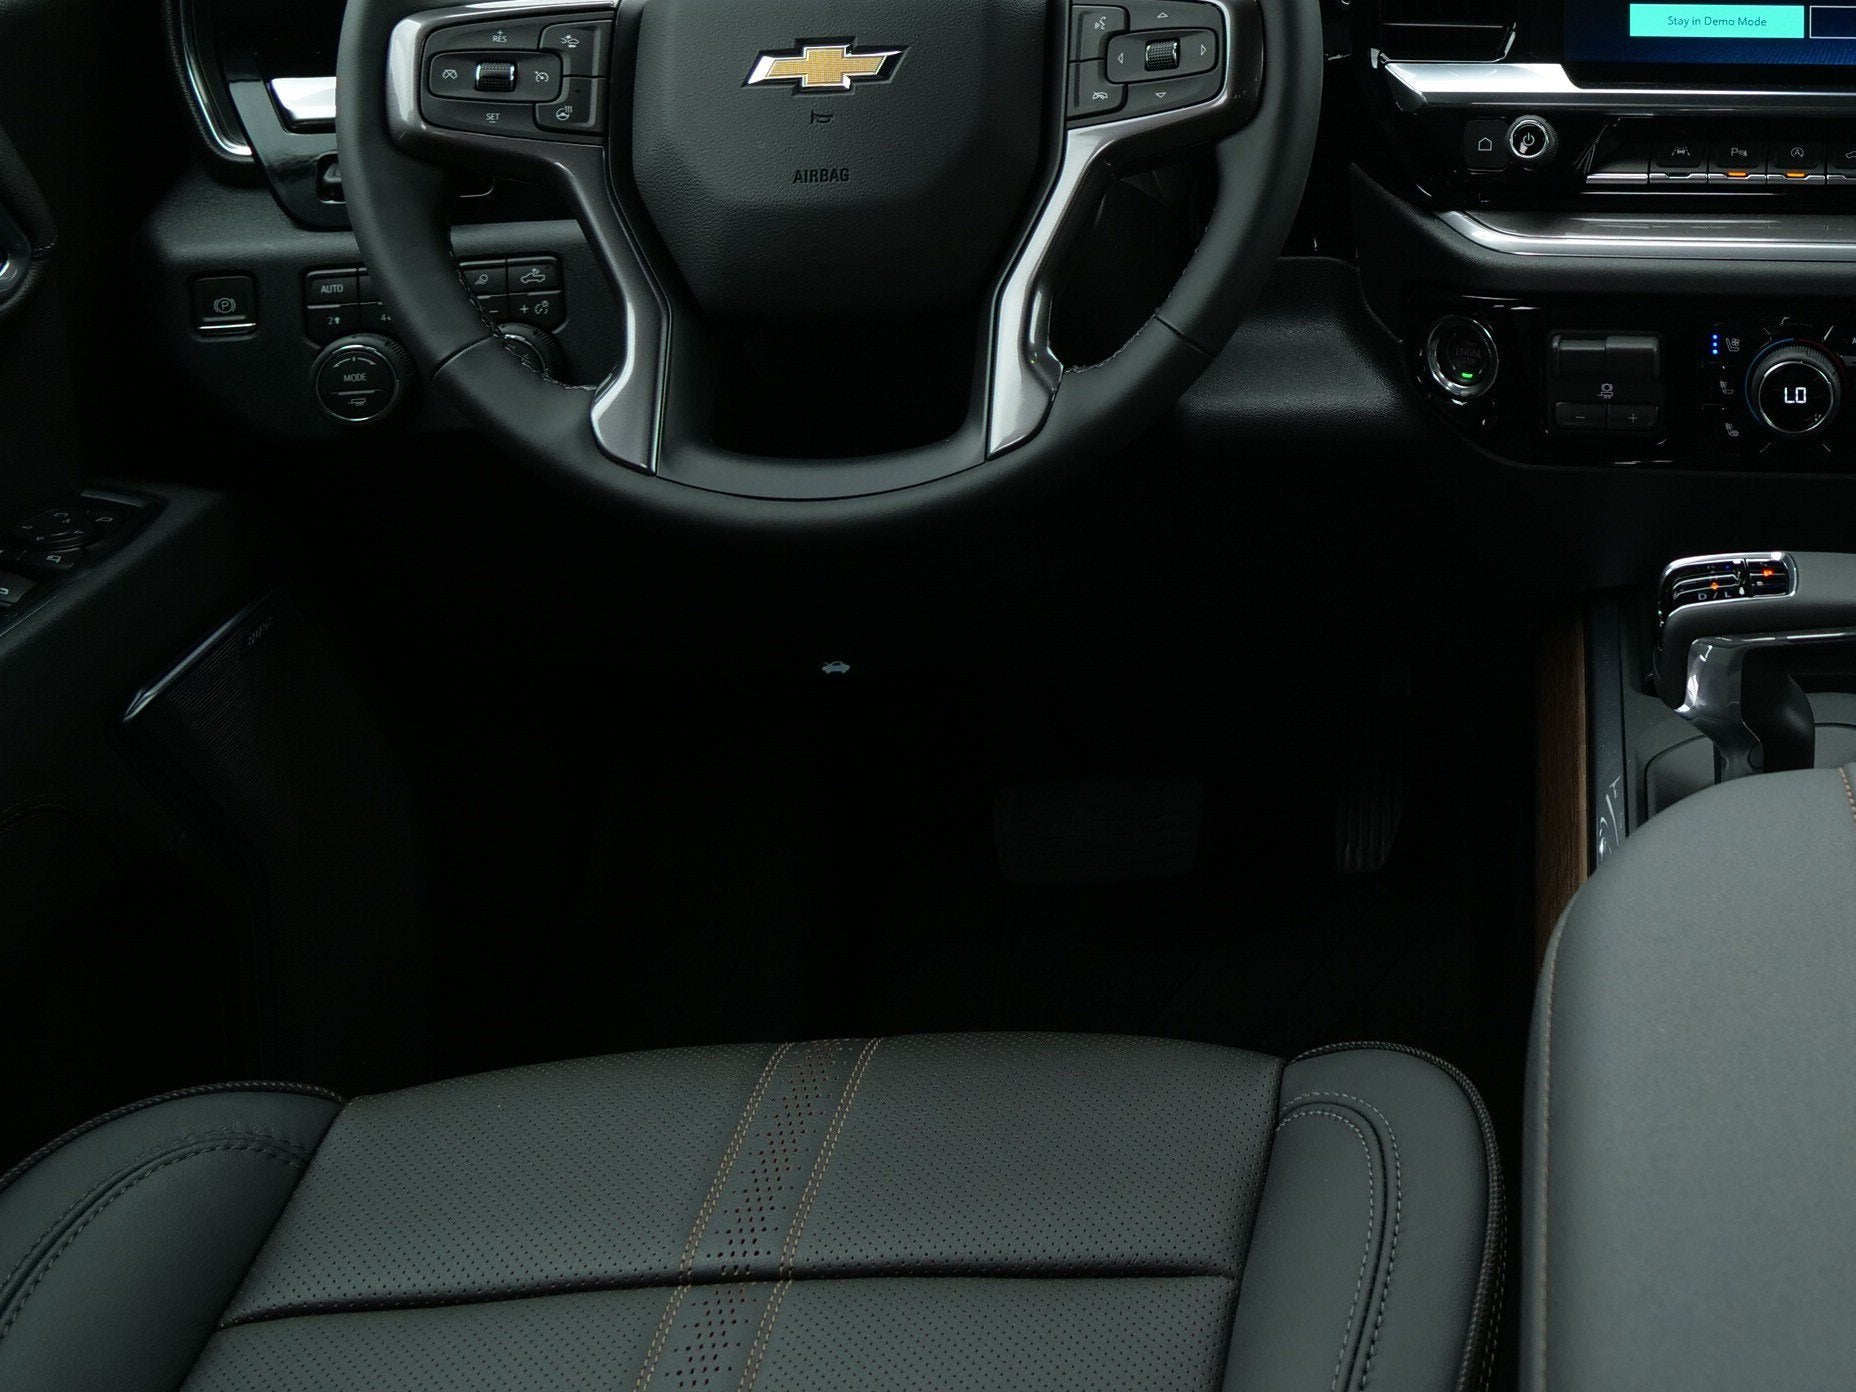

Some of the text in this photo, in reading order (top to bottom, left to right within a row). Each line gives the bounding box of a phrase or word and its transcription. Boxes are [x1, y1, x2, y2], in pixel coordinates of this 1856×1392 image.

[1667, 15, 1767, 29] Stay in Demo Mode
[493, 35, 507, 43] RES
[485, 113, 500, 122] SET
[793, 168, 850, 185] AIRBAG
[320, 284, 344, 294] AUTO
[343, 372, 368, 382] MODE
